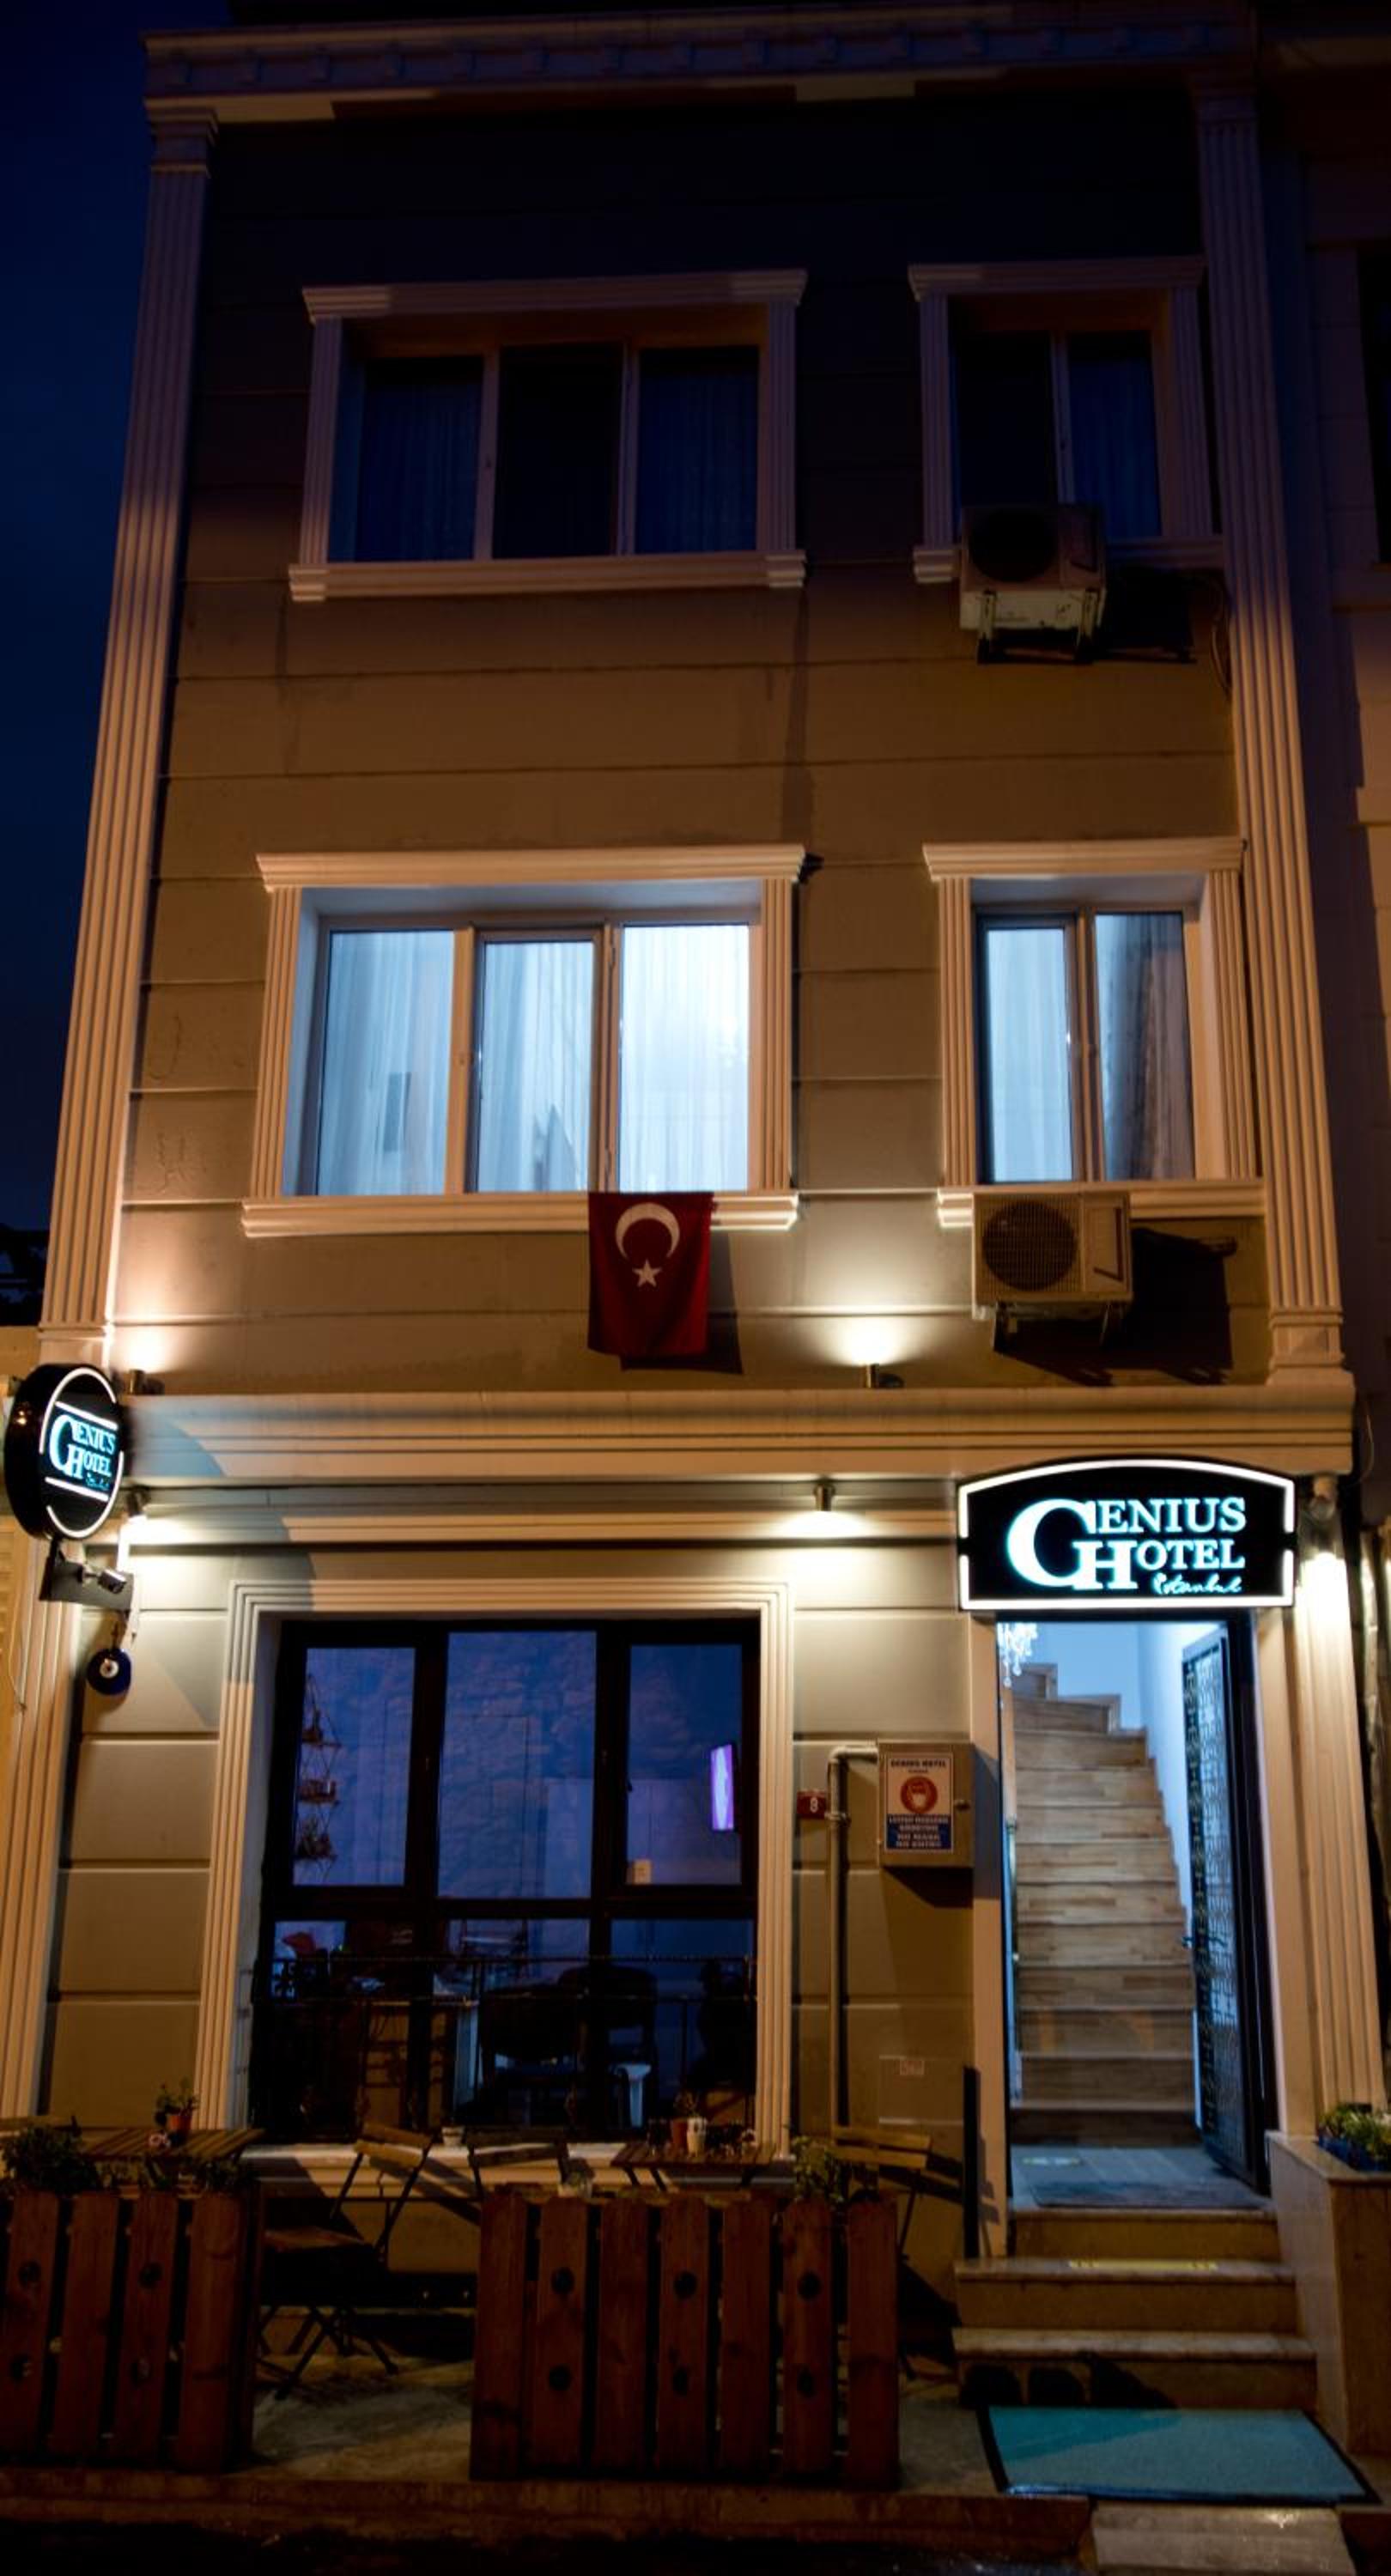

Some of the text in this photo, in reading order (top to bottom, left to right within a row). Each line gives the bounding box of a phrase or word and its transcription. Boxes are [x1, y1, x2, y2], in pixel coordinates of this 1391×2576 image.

[49, 1414, 116, 1474] GENIUS
[67, 1443, 112, 1479] HOTEL
[1006, 1497, 1247, 1587] GENIUS
[1072, 1539, 1246, 1590] HOTEL
